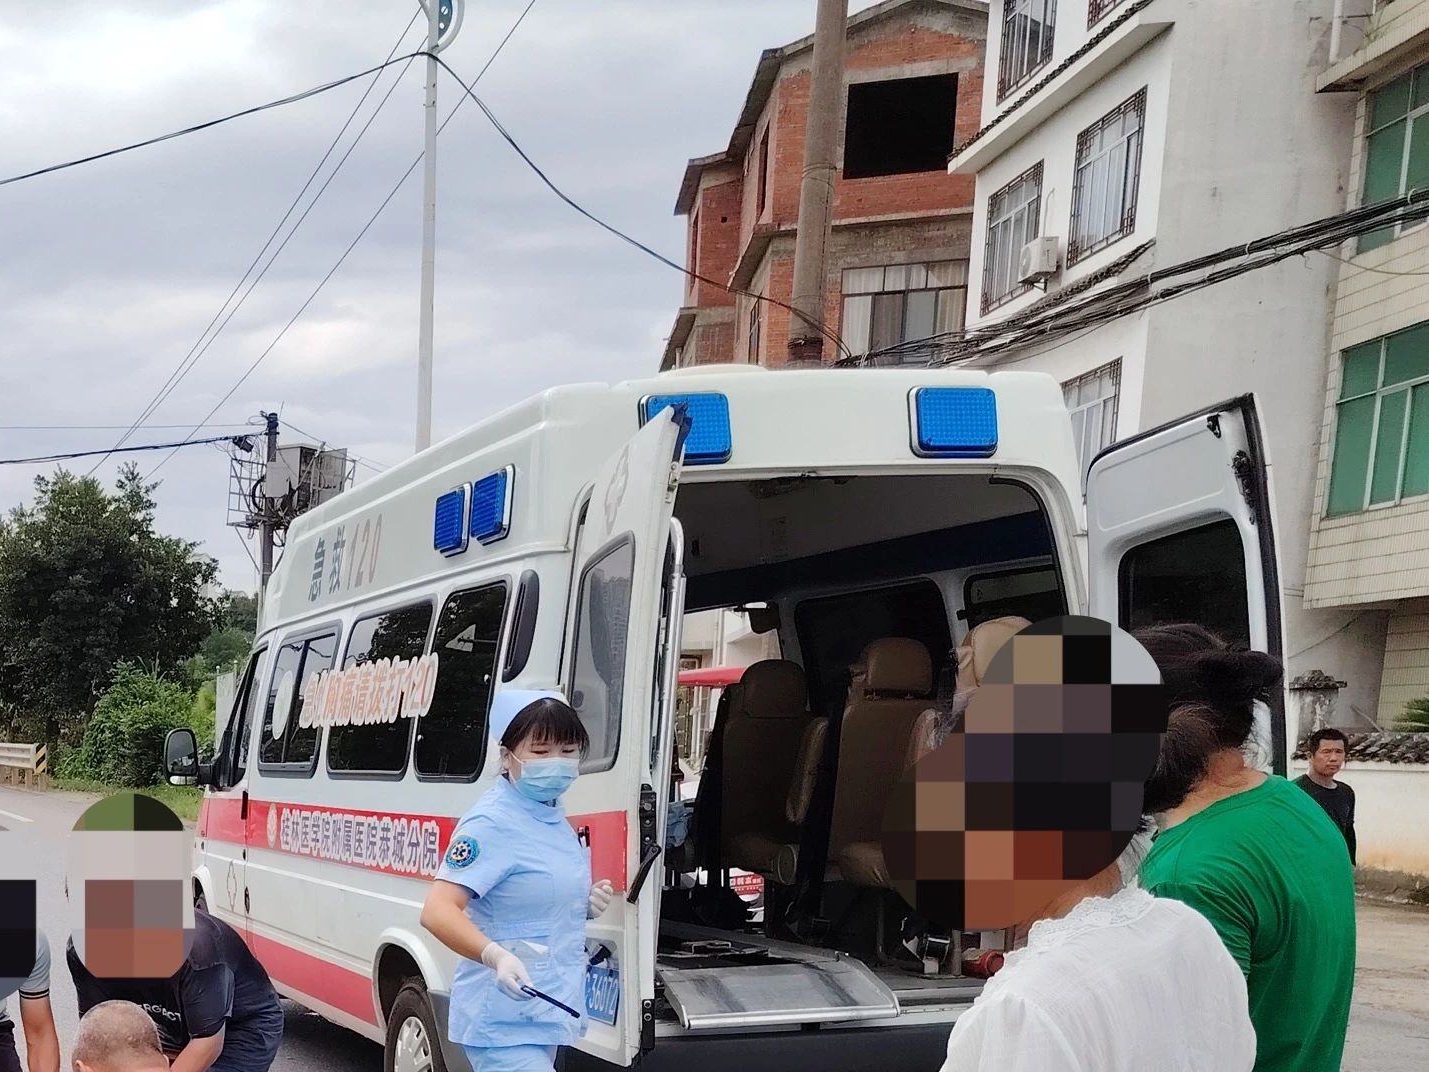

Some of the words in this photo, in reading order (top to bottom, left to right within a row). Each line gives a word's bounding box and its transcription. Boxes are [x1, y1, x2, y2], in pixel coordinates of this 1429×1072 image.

[307, 512, 383, 602] 急救120
[281, 808, 440, 876] 桂林医学院附属医院恭城分院
